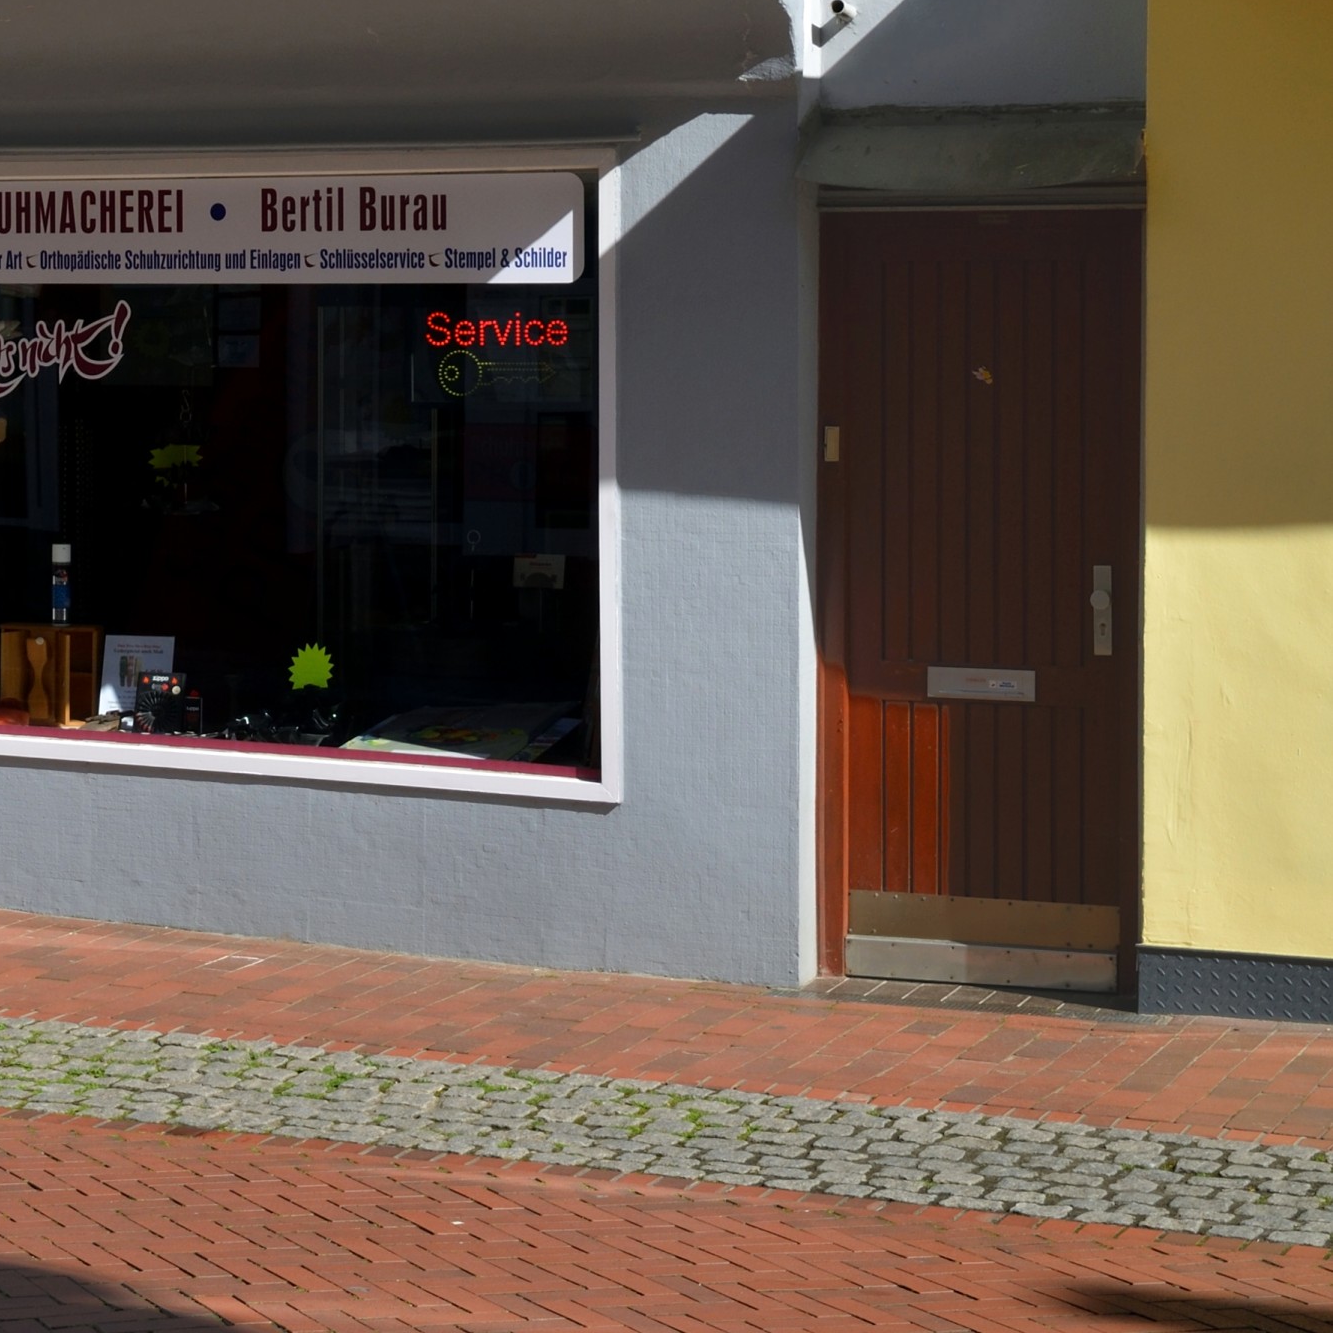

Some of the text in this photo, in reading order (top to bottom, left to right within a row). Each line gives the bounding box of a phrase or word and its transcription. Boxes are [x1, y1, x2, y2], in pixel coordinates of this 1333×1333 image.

[261, 187, 344, 232] Bertil
[359, 186, 447, 231] Burau
[6, 250, 23, 270] Art
[40, 249, 121, 271] Orthopädische
[125, 249, 221, 271] Schuhzurichtung
[225, 249, 246, 270] und
[250, 249, 301, 271] Einlagen
[320, 248, 425, 269] Schlüsselservice
[444, 247, 496, 270] Stempel
[500, 248, 511, 268] &
[514, 247, 567, 268] Schilder
[17, 300, 131, 385] nicht!
[426, 311, 568, 346] Service
